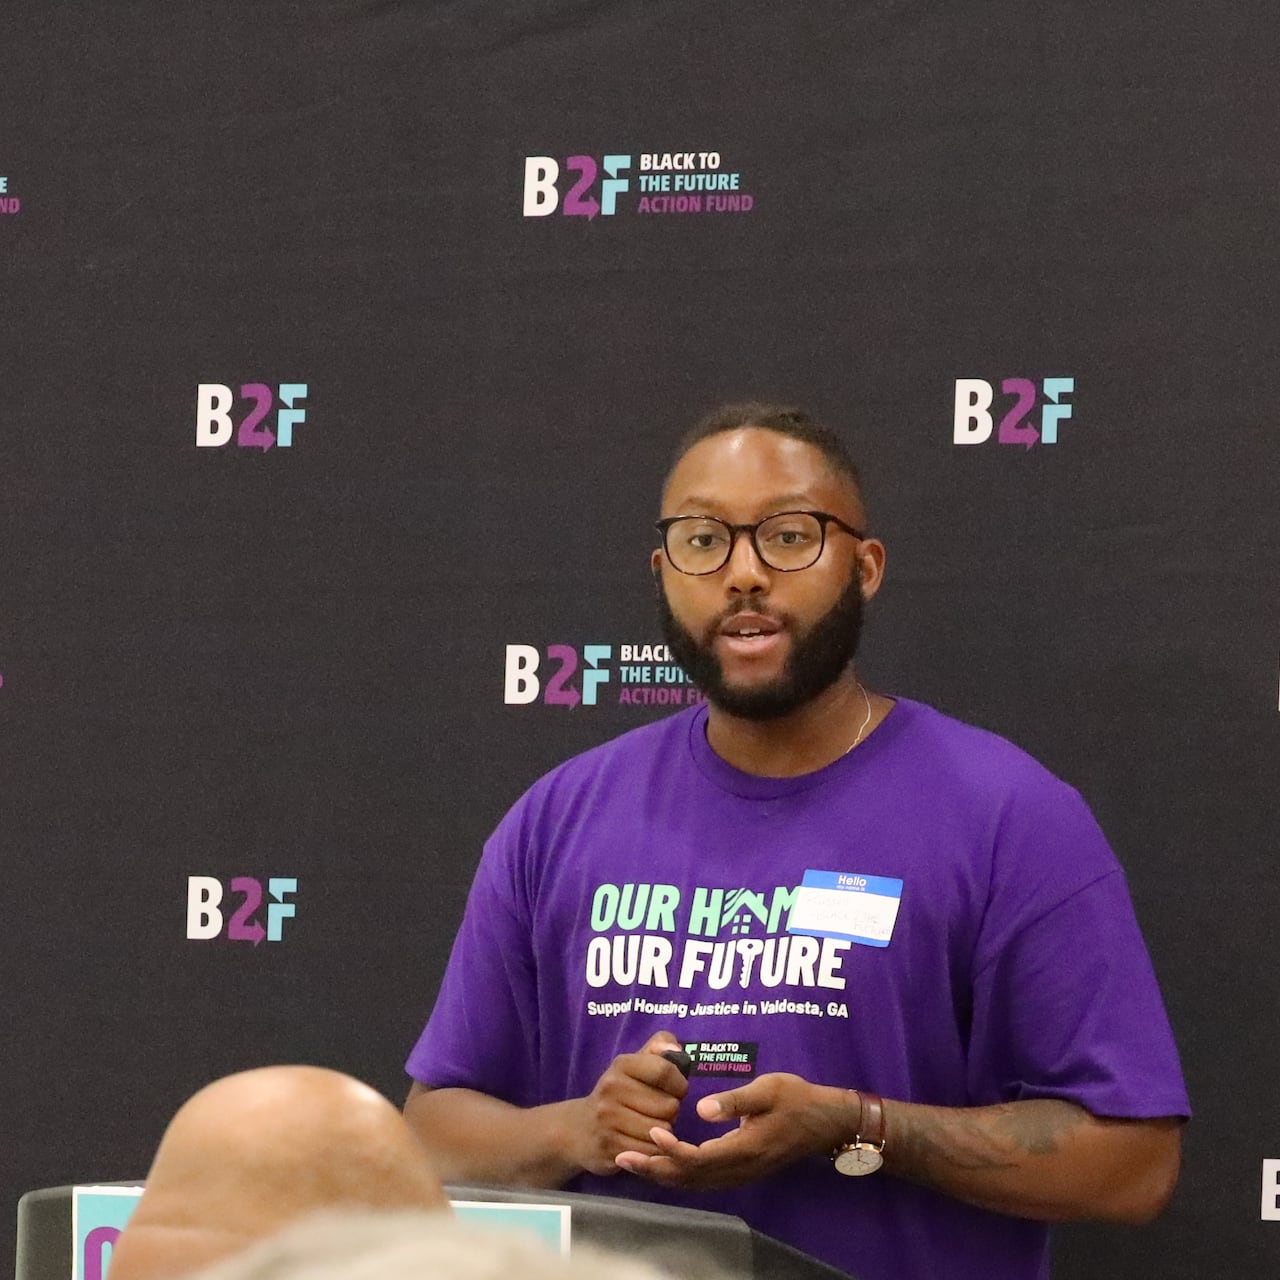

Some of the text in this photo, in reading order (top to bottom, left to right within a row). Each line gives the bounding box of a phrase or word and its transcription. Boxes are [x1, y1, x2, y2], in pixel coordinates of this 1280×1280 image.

[638, 152, 721, 170] BLACK TO
[523, 155, 632, 220] B2F
[637, 172, 740, 191] THE FUTURE
[638, 194, 753, 212] ACTION FUND
[195, 383, 308, 451] B2F
[953, 377, 1074, 450] B2F
[503, 644, 612, 711] B2F
[620, 665, 651, 683] THE
[620, 687, 682, 705] ACTION
[838, 875, 867, 887] Hello
[187, 875, 298, 947] B2F
[590, 883, 680, 932] OUR
[585, 935, 852, 990] OUR FUTURE
[634, 997, 688, 1018] Housing
[690, 1001, 739, 1016] Justice
[742, 1000, 757, 1015] in
[760, 998, 823, 1018] Valdosta,
[827, 1001, 849, 1018] GA
[700, 1043, 739, 1052] BLACK TO
[699, 1053, 748, 1063] THE FUTURE
[697, 1063, 752, 1073] ACTION FUND
